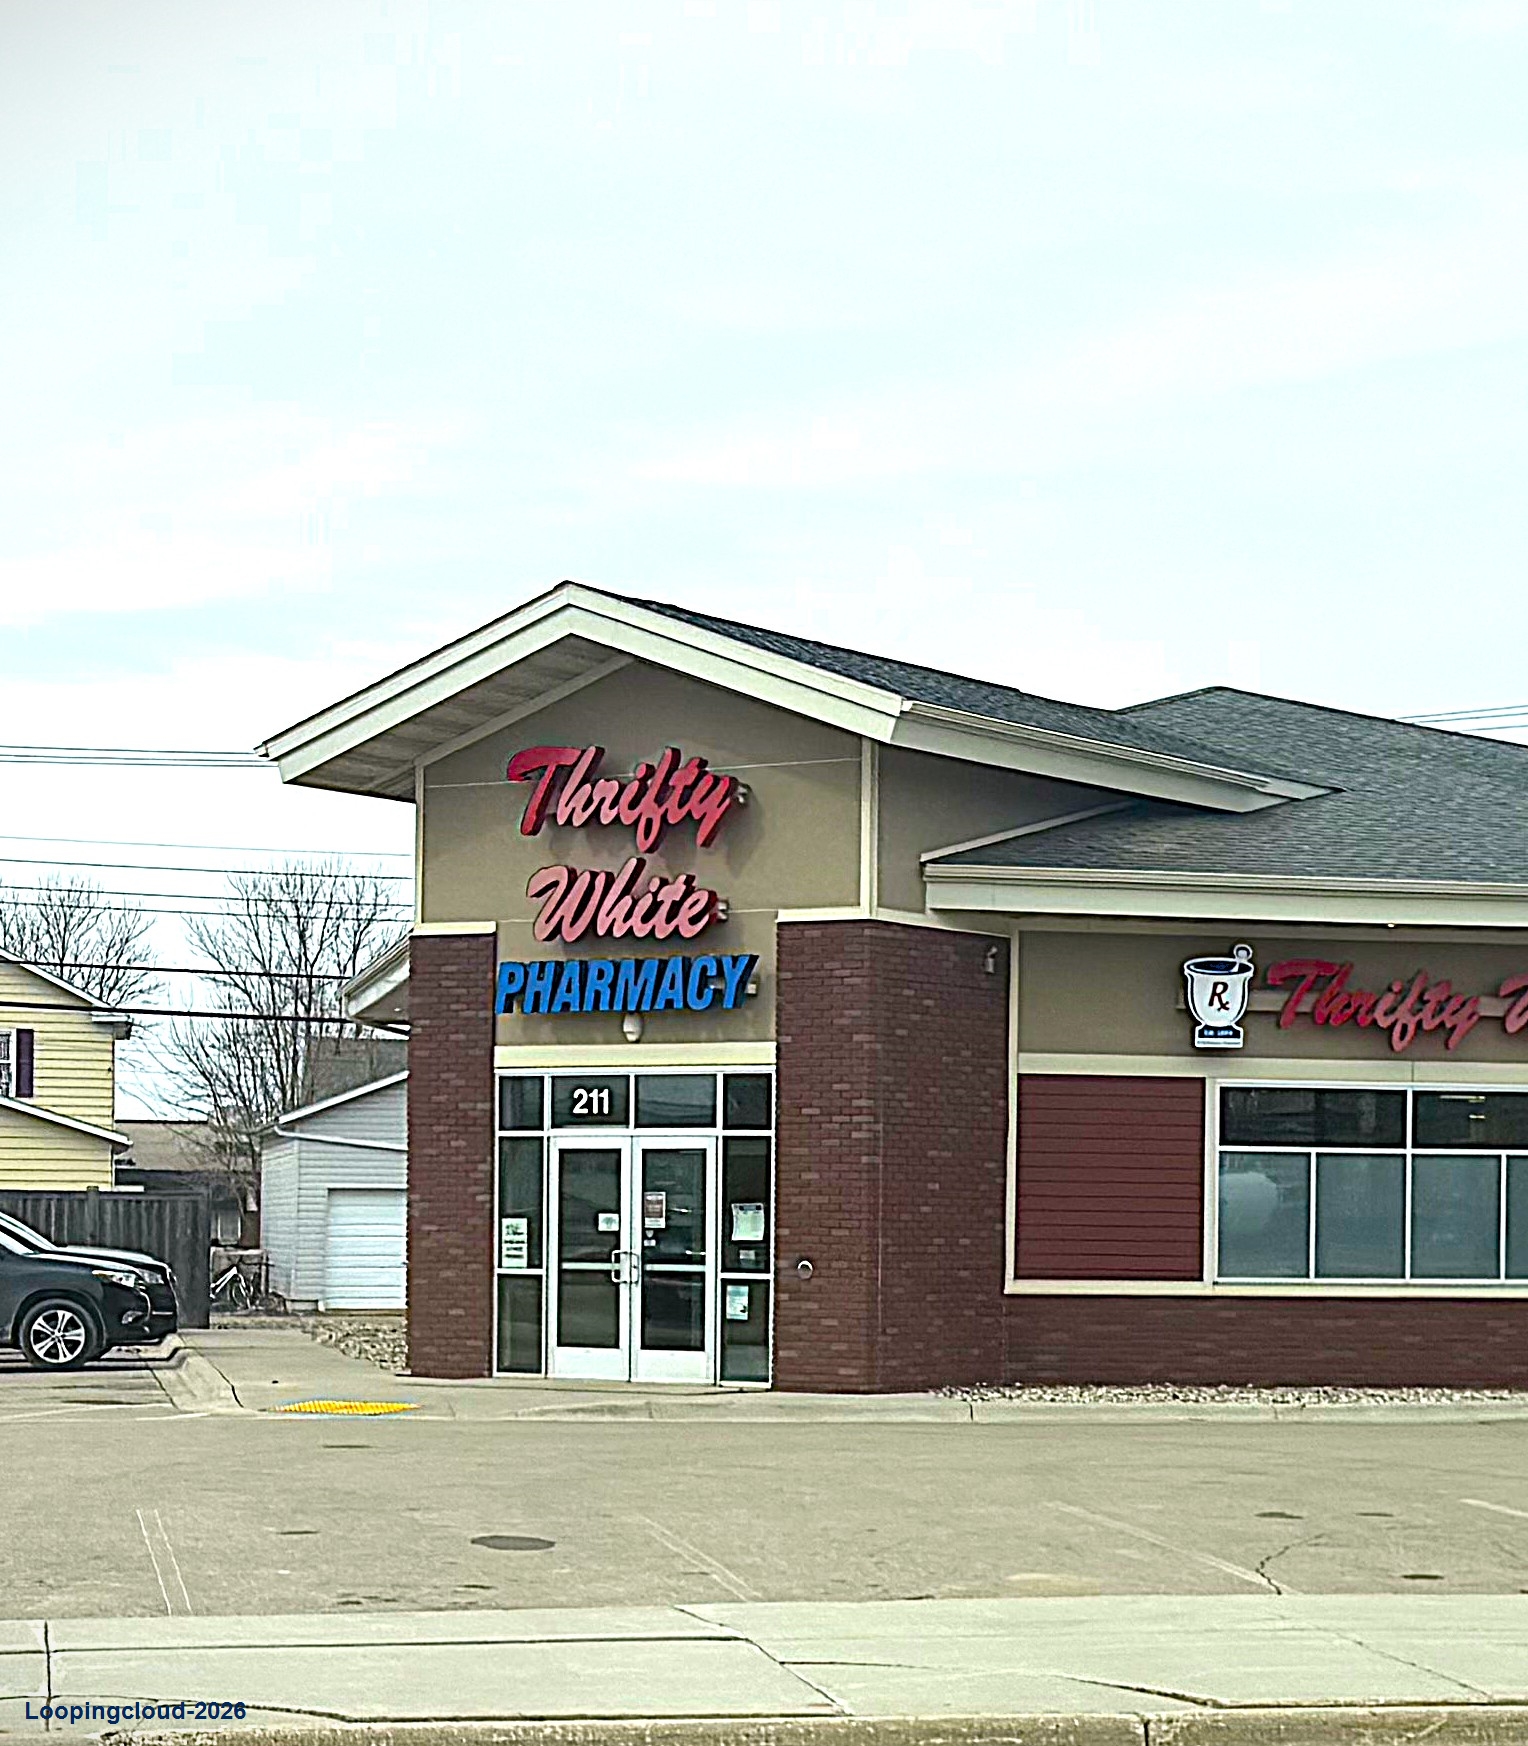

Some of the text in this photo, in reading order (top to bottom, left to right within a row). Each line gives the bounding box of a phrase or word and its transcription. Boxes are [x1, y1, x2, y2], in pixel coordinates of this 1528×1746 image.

[507, 746, 736, 853] Thrifty
[526, 857, 717, 942] White
[495, 954, 758, 1014] PHARMACY
[1266, 959, 1481, 1052] Thrifty
[572, 1088, 609, 1115] 211
